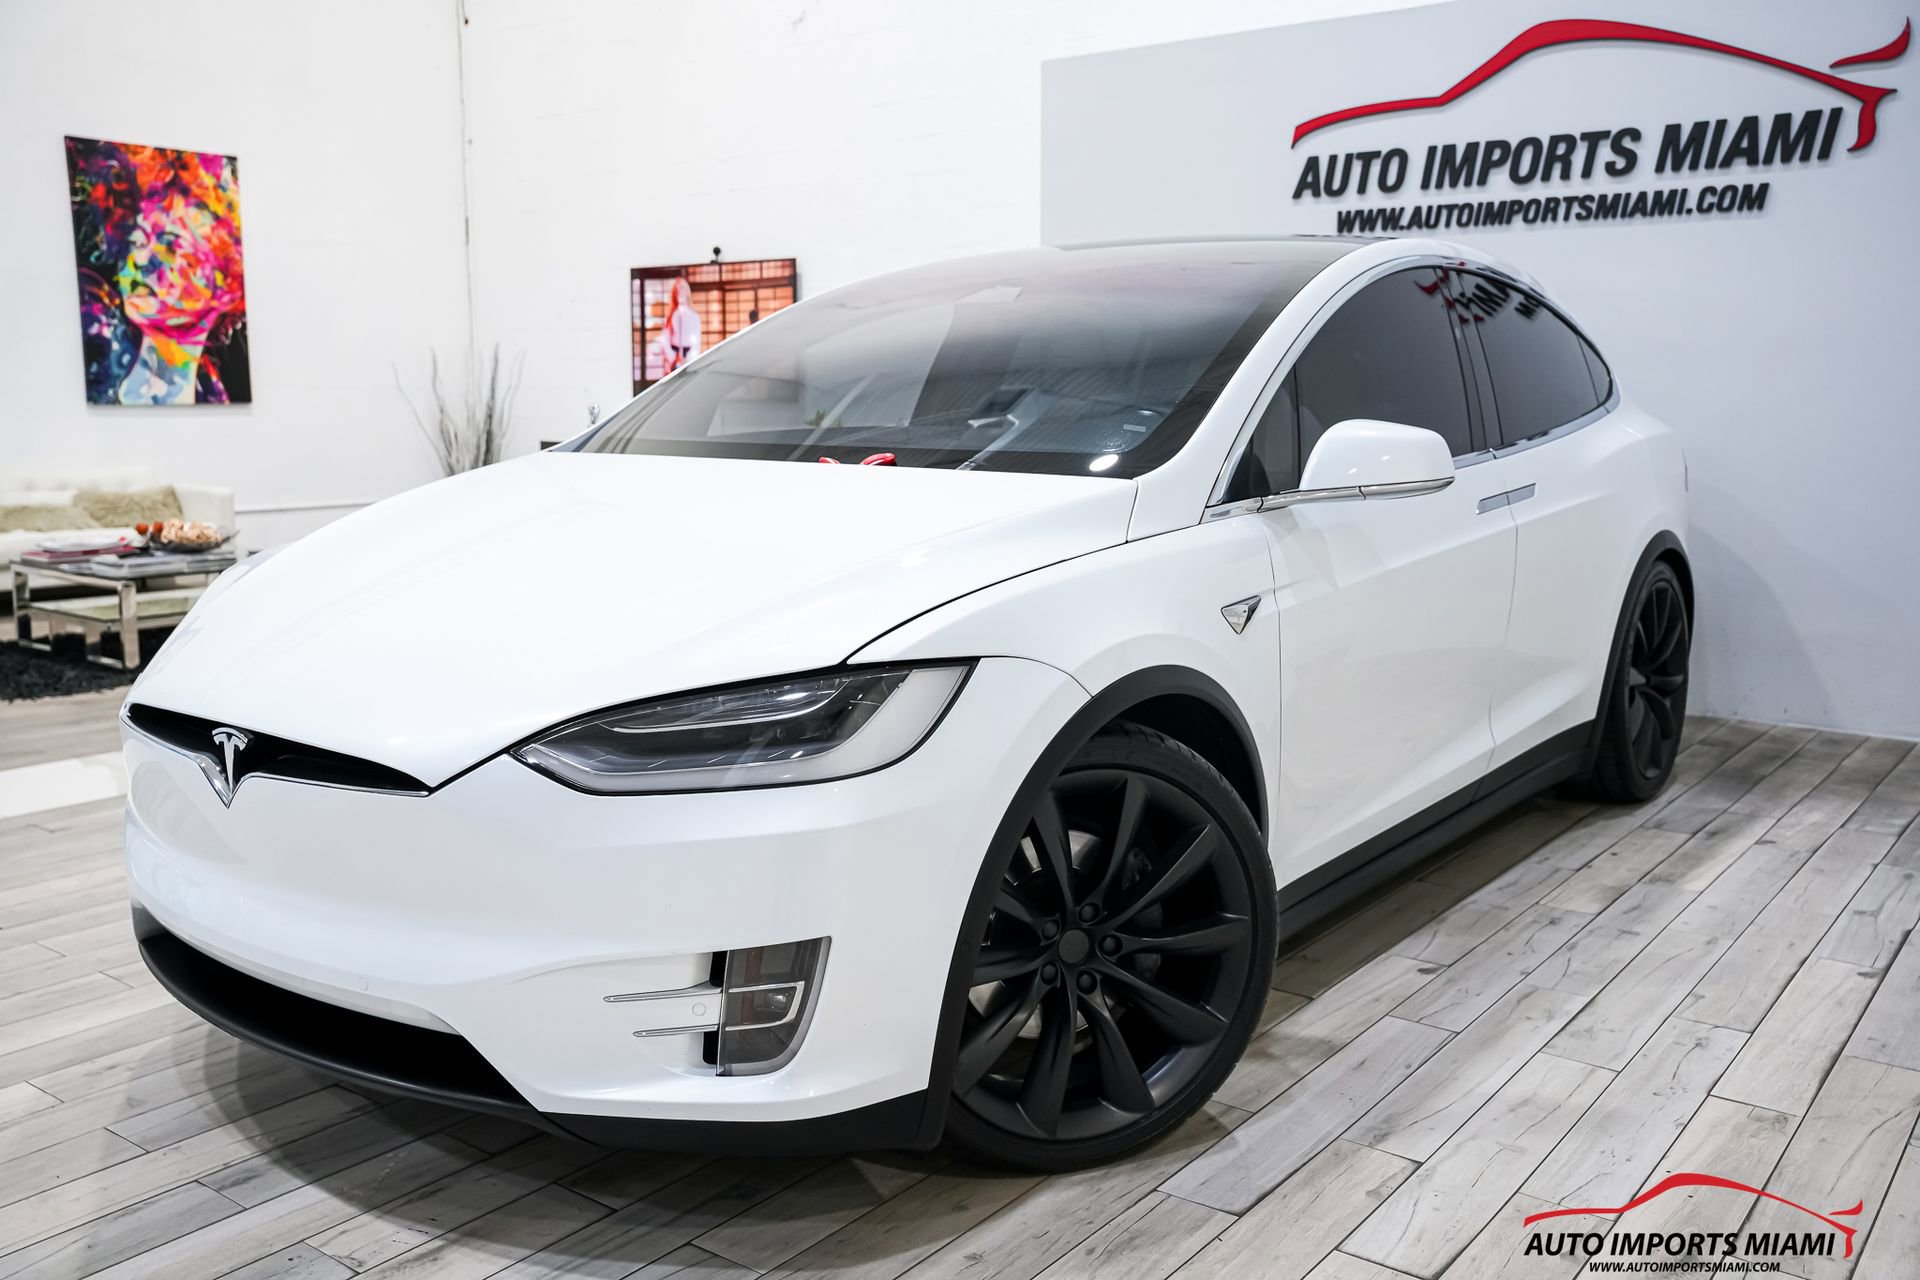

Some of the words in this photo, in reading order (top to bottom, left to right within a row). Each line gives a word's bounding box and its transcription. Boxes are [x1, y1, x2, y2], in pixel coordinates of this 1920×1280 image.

[1292, 146, 1409, 200] AUTO
[1420, 127, 1642, 191] IMPORTS
[1654, 106, 1844, 175] MIAMI
[1336, 182, 1770, 235] WWW.AUTOIMPORTSMIAMI.COM
